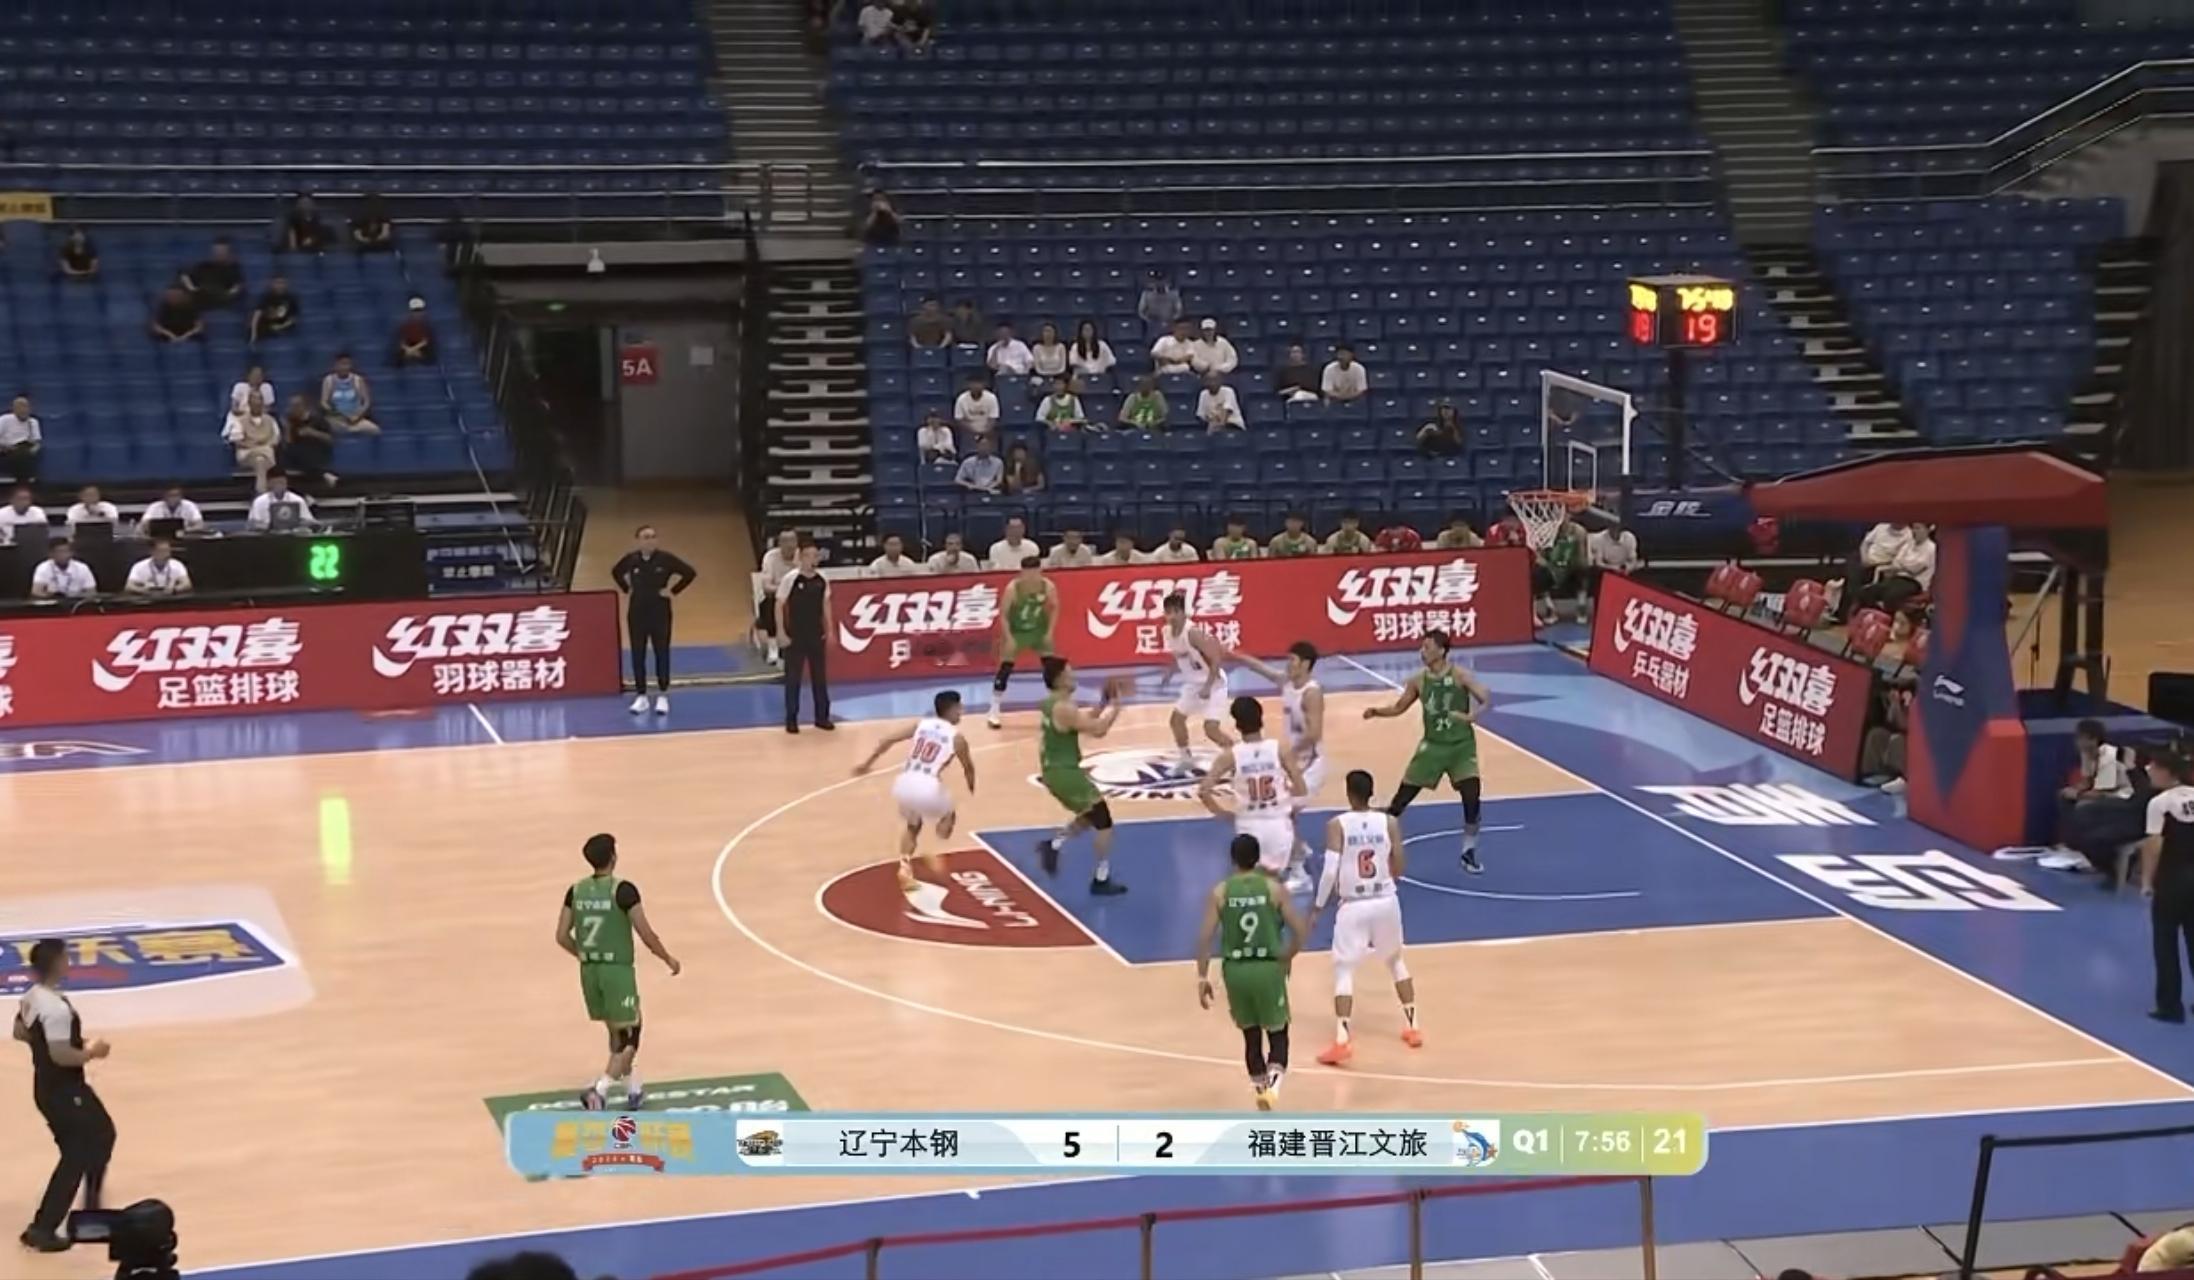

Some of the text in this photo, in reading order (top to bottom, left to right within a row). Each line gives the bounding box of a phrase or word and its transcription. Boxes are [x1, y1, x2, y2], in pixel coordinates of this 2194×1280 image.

[1688, 314, 1717, 343] 19
[622, 358, 653, 377] 5A
[1327, 557, 1479, 626] 红双喜
[372, 605, 571, 677] 红双喜
[839, 583, 1000, 652] 红双喜
[1613, 597, 1699, 661] 红双喜
[92, 617, 303, 692] 红双喜
[433, 656, 567, 694] 羽球器材
[1632, 650, 1690, 699] 乒乓器材
[157, 670, 300, 709] 足篮排球
[1738, 646, 1837, 717] 红双喜
[1759, 703, 1827, 756] 足篮排球
[1358, 849, 1377, 879] 6
[582, 915, 604, 947] 7
[1239, 911, 1259, 943] 9
